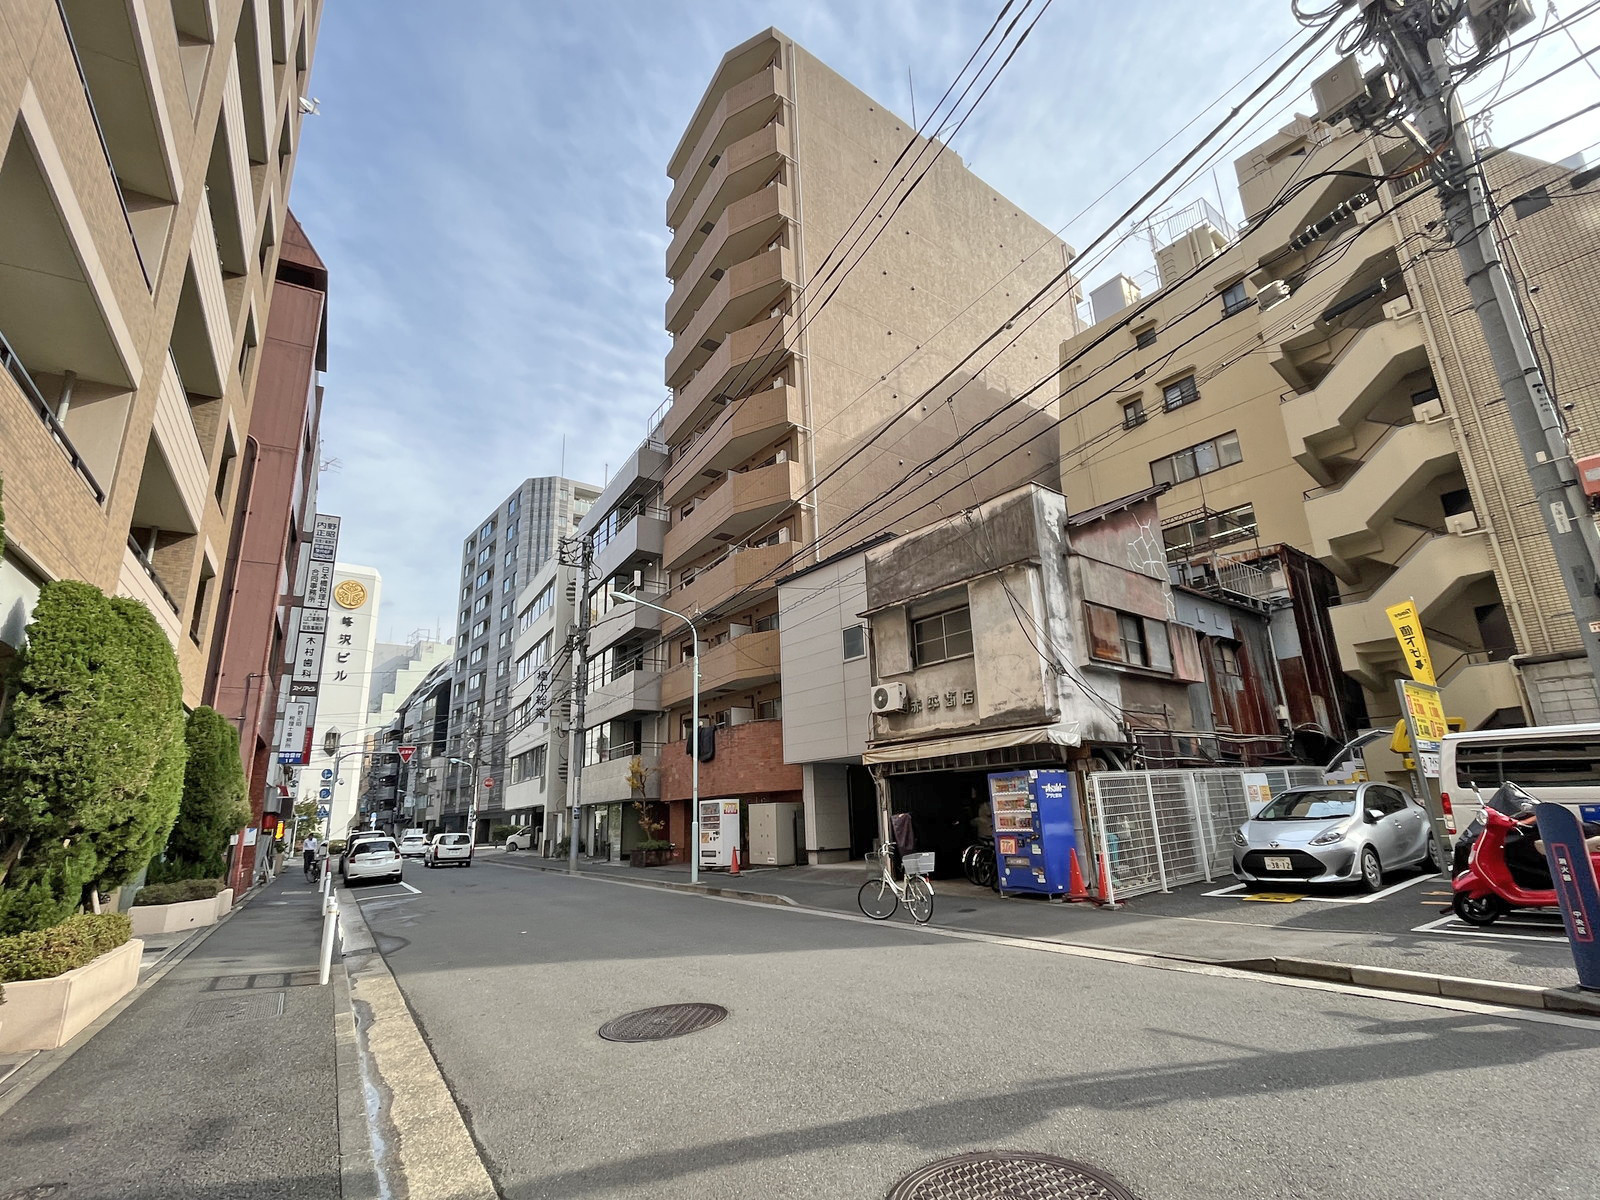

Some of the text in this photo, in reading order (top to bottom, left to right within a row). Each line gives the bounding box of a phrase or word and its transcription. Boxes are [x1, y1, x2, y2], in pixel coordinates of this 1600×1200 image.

[317, 522, 337, 530] 内野
[308, 568, 319, 603] 合同事務所
[318, 567, 329, 607] 日本橋税理士
[301, 637, 316, 678] 木村歯科
